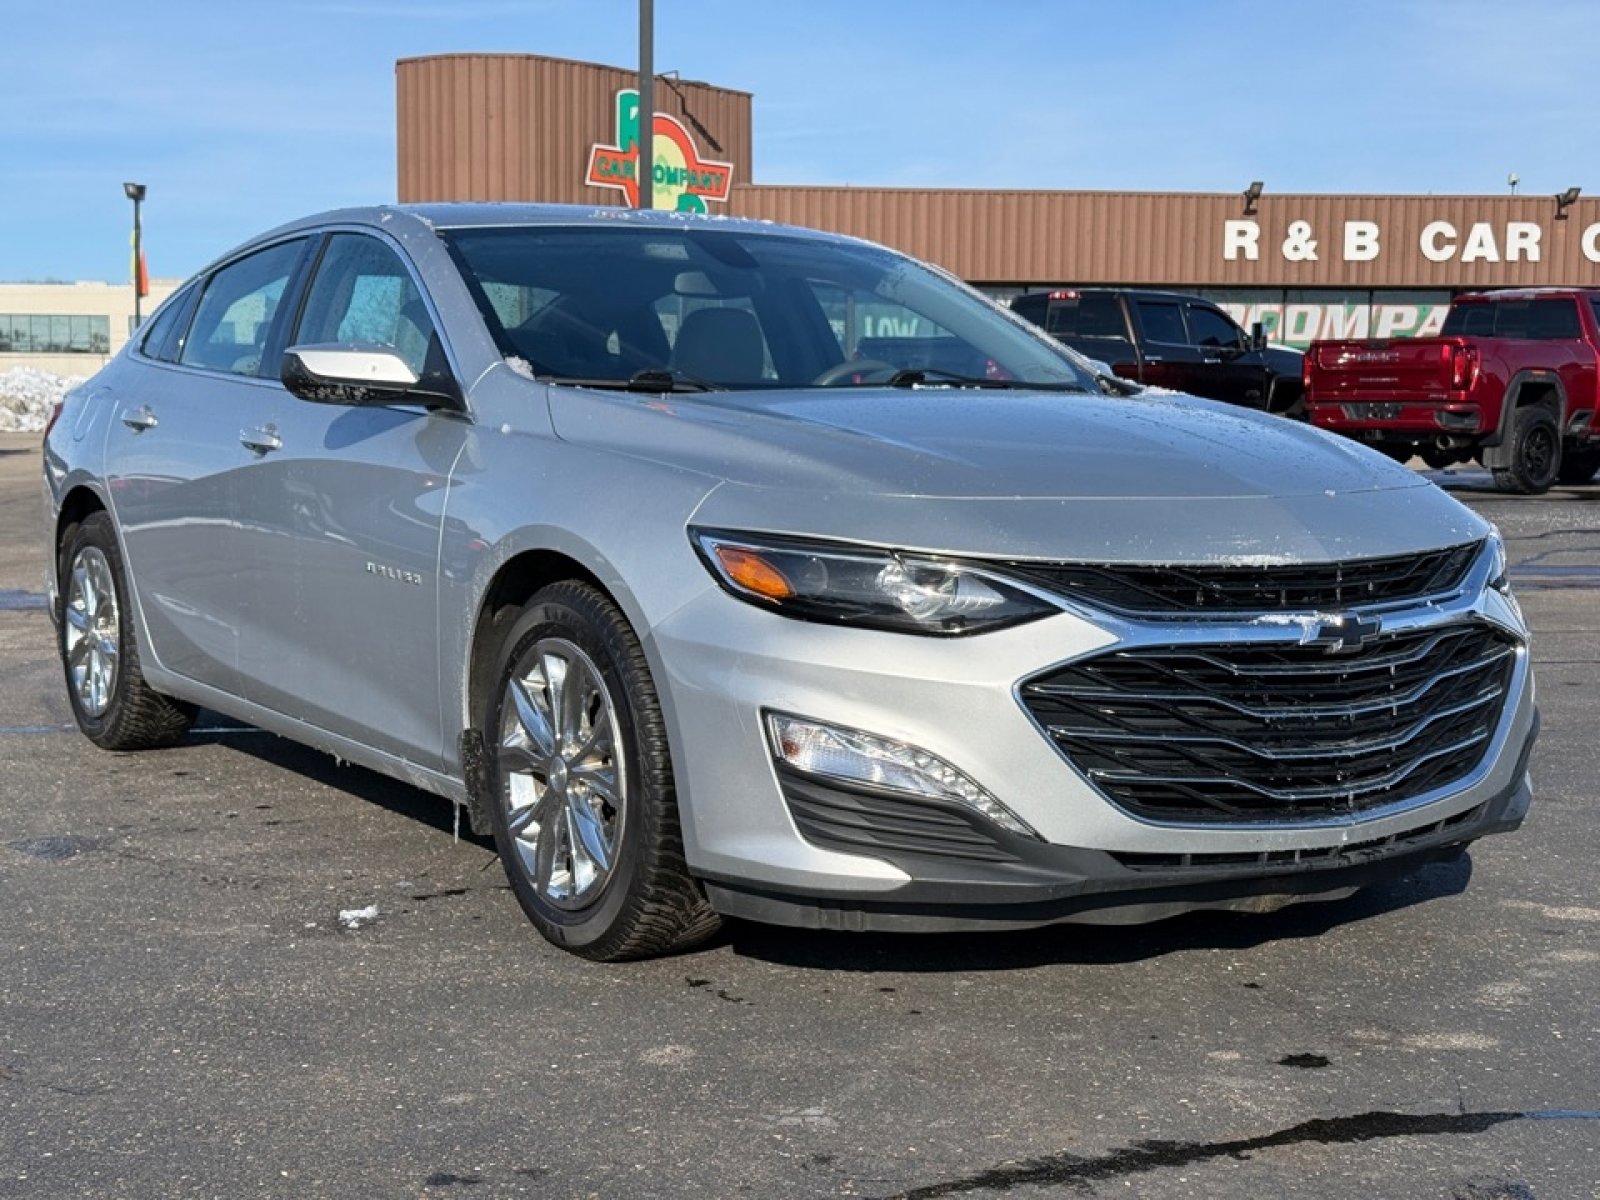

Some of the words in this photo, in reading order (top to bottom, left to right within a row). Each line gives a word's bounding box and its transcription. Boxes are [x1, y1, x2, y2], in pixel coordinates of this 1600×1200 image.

[652, 164, 724, 193] OMPANY
[1224, 220, 1260, 261] R
[1282, 220, 1319, 262] &
[1344, 221, 1380, 261] B
[1419, 221, 1542, 263] CAR
